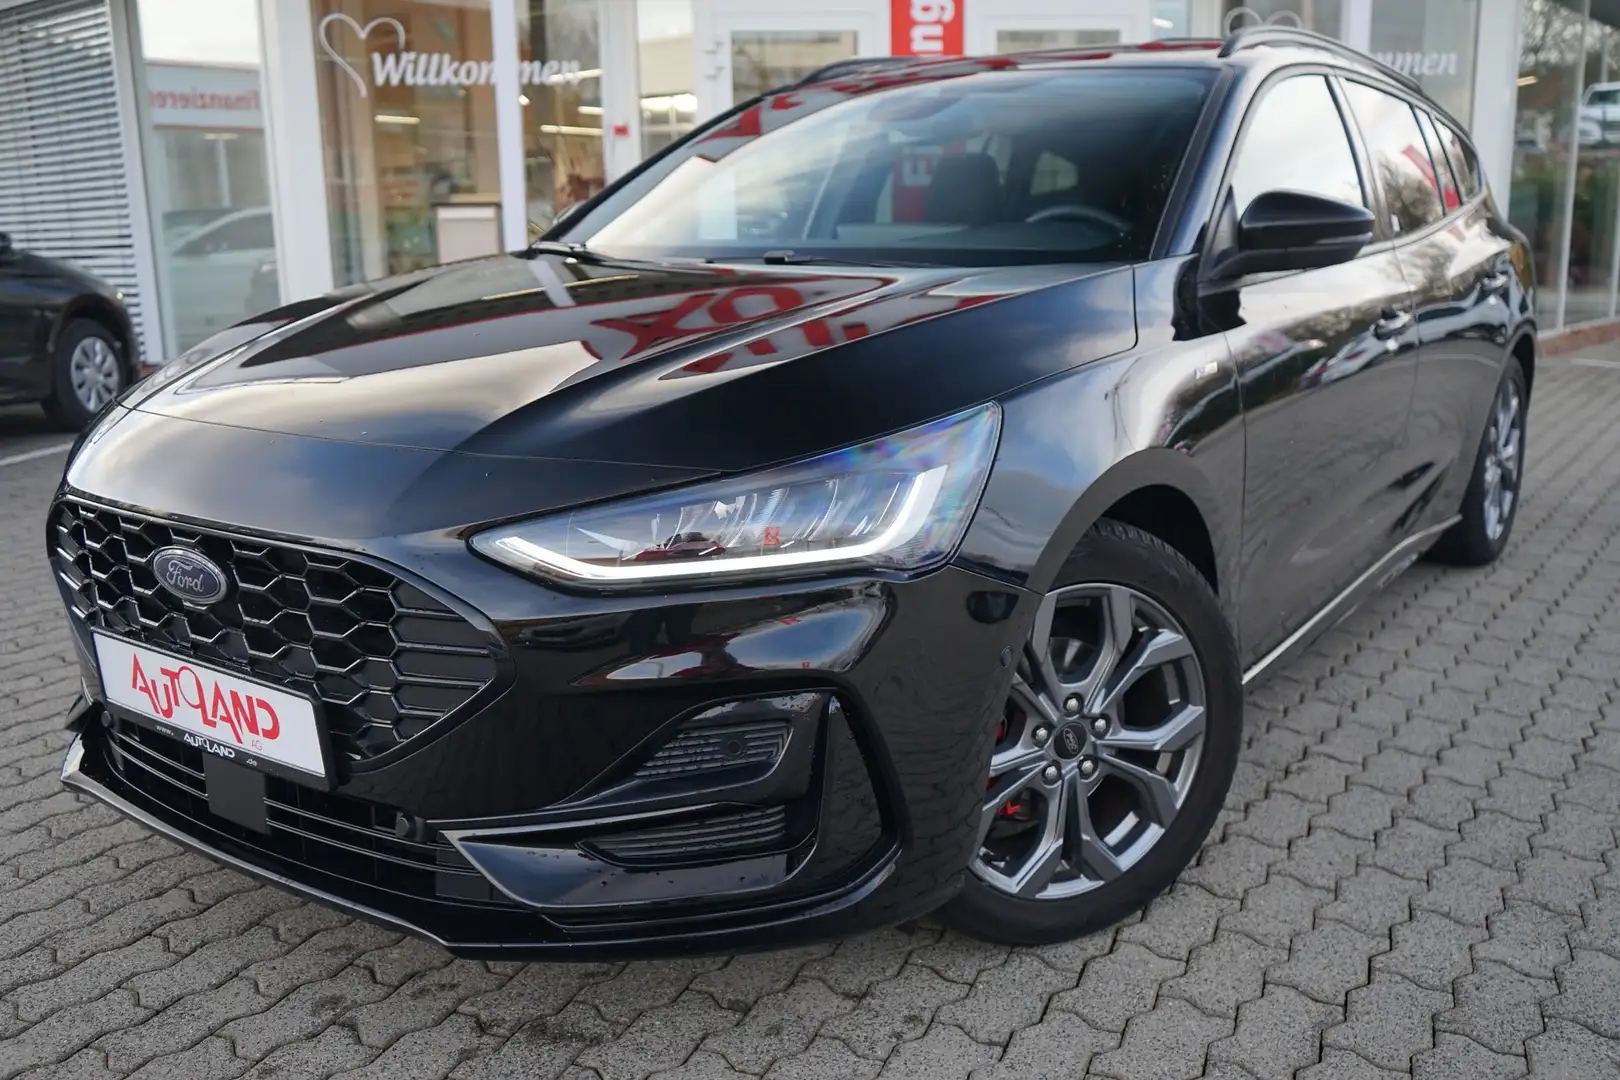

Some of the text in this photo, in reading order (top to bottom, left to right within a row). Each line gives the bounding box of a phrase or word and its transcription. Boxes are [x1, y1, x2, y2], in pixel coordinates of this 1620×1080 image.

[166, 560, 205, 592] Ford
[131, 651, 280, 745] AUTOLAND
[183, 732, 236, 759] AUTOLAND
[251, 739, 263, 751] AG
